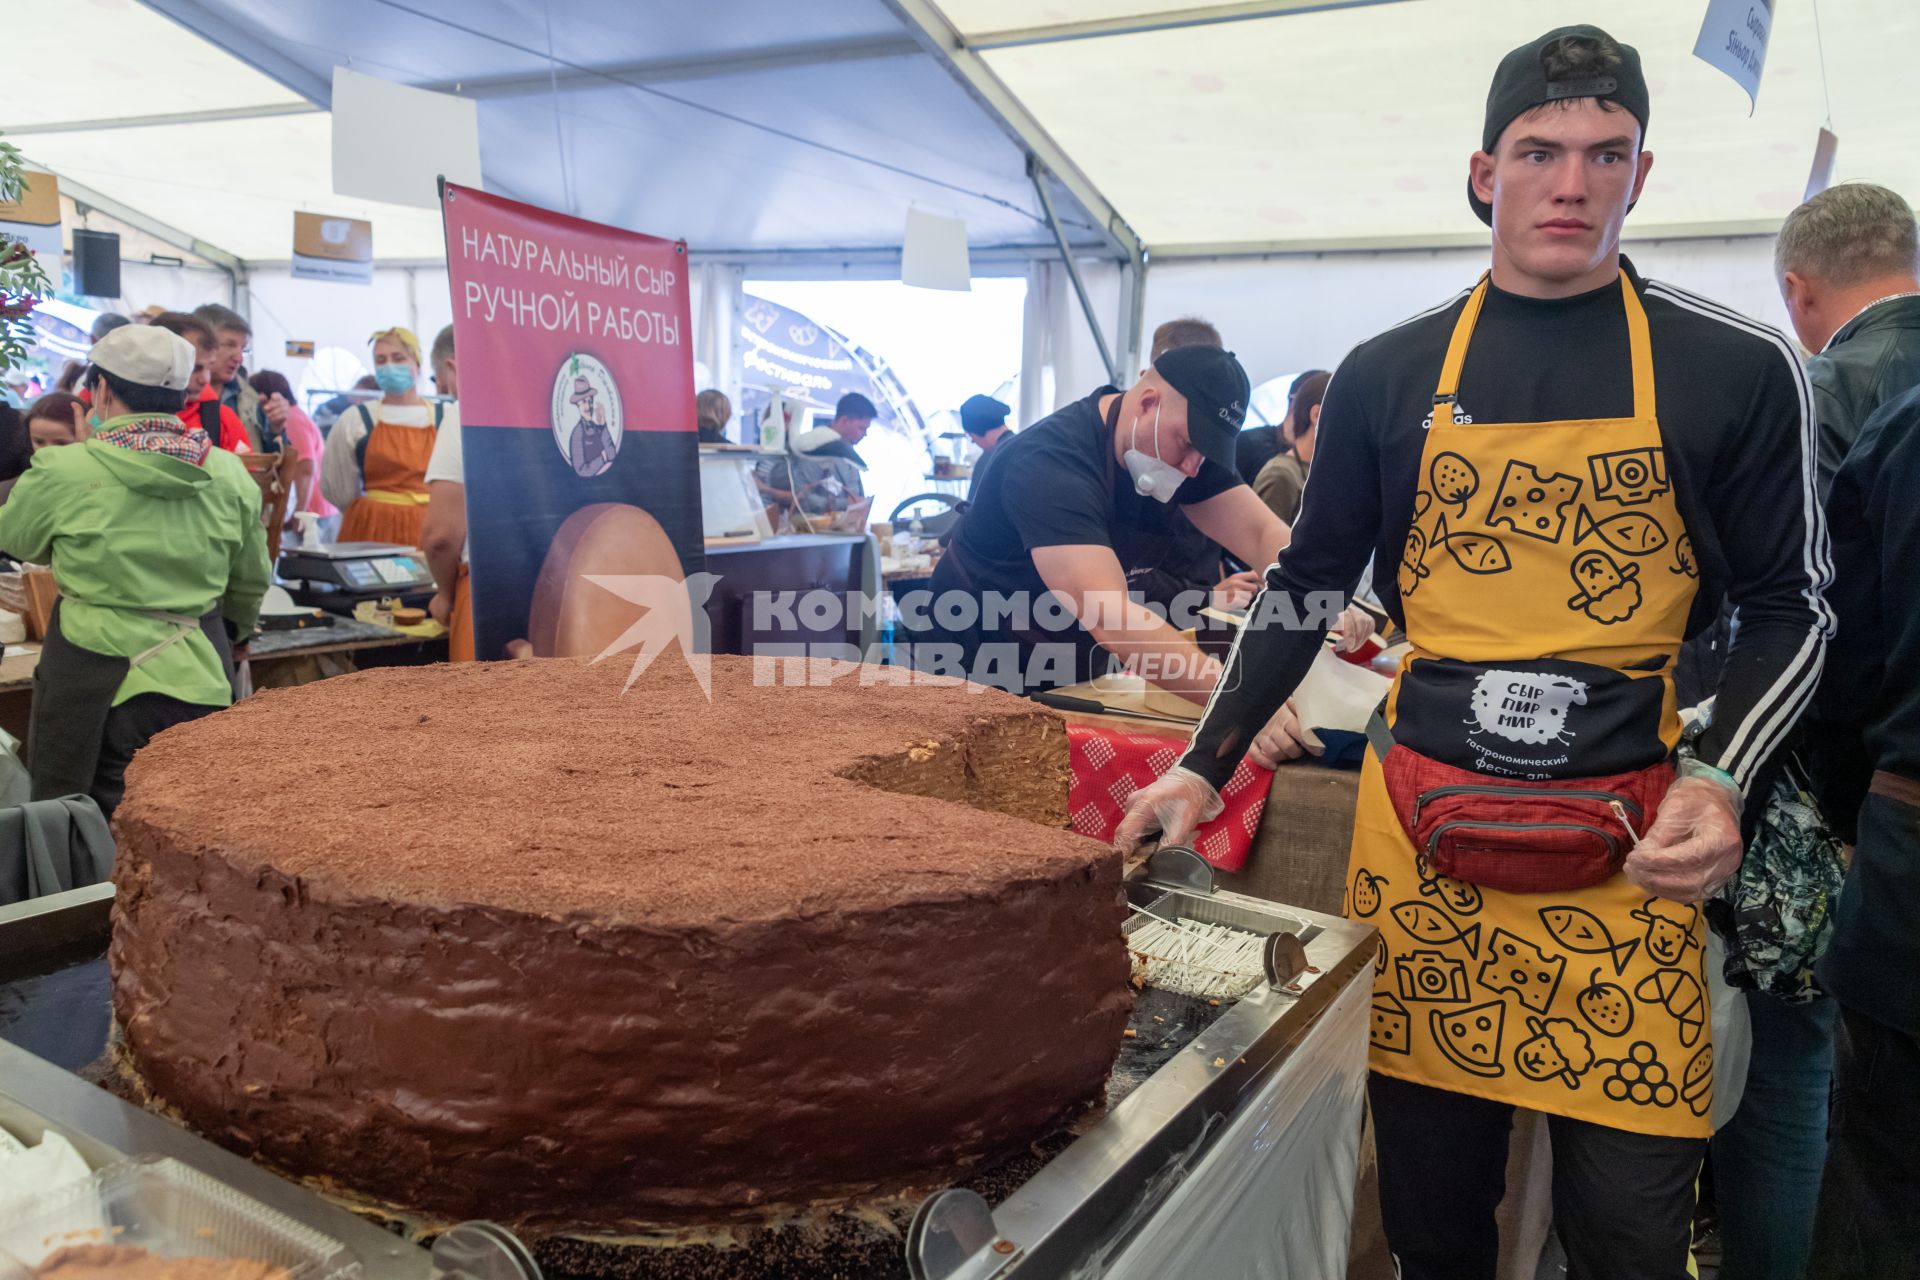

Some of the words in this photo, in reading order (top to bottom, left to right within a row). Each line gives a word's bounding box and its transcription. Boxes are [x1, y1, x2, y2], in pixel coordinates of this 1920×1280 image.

[462, 226, 630, 290] НАТУРАЛЬНЫЙ
[634, 265, 676, 296] СЫР
[465, 280, 580, 333] РУЧНОЙ
[587, 302, 680, 346] РАБОТЫ
[1422, 415, 1473, 429] aas
[1507, 683, 1544, 699] СЫР
[1501, 697, 1540, 714] ПИР
[1497, 714, 1535, 728] МИР
[1466, 738, 1568, 767] гастрономический
[1475, 757, 1552, 780] фестиаль
